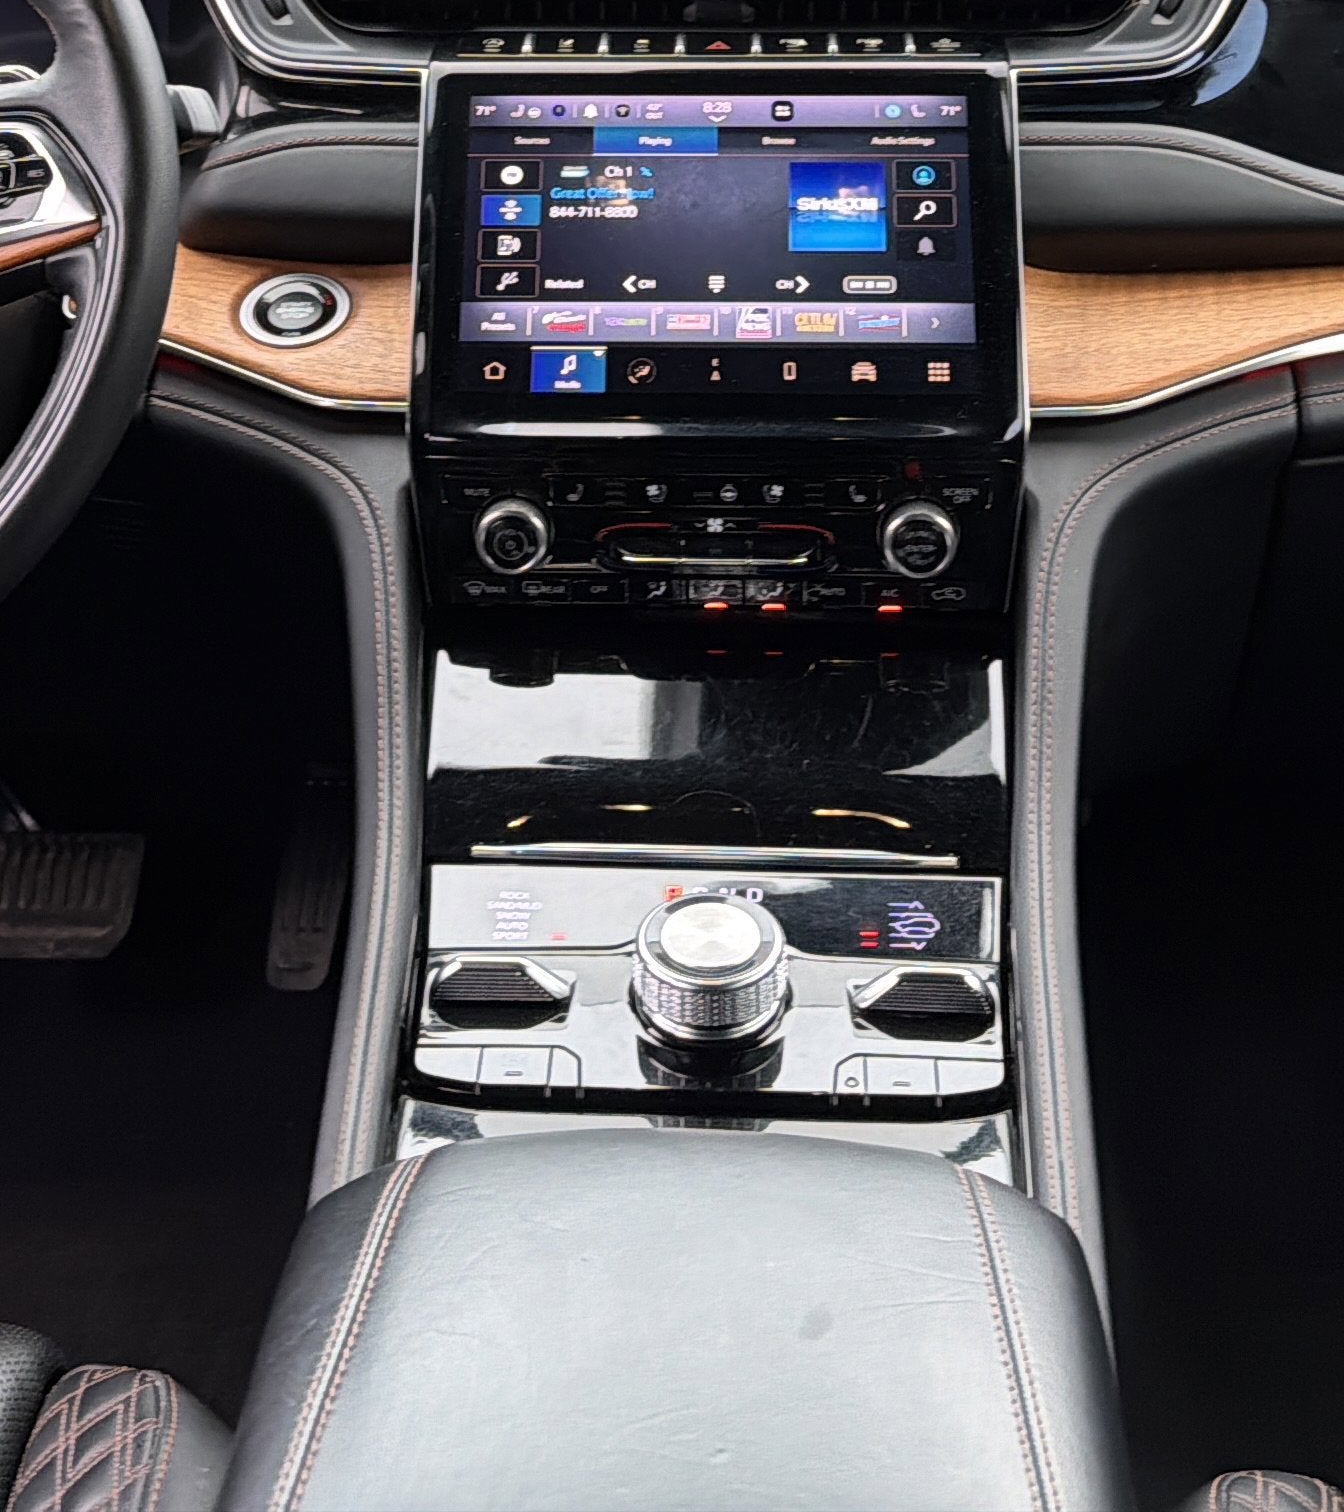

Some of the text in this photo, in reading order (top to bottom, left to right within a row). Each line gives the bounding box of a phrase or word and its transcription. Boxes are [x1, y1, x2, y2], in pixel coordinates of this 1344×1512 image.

[702, 100, 733, 114] 8:28
[638, 136, 673, 147] Playing
[604, 165, 633, 178] Ch 1
[549, 187, 586, 200] Great
[796, 196, 879, 211] SiriusXM
[745, 887, 765, 904] D
